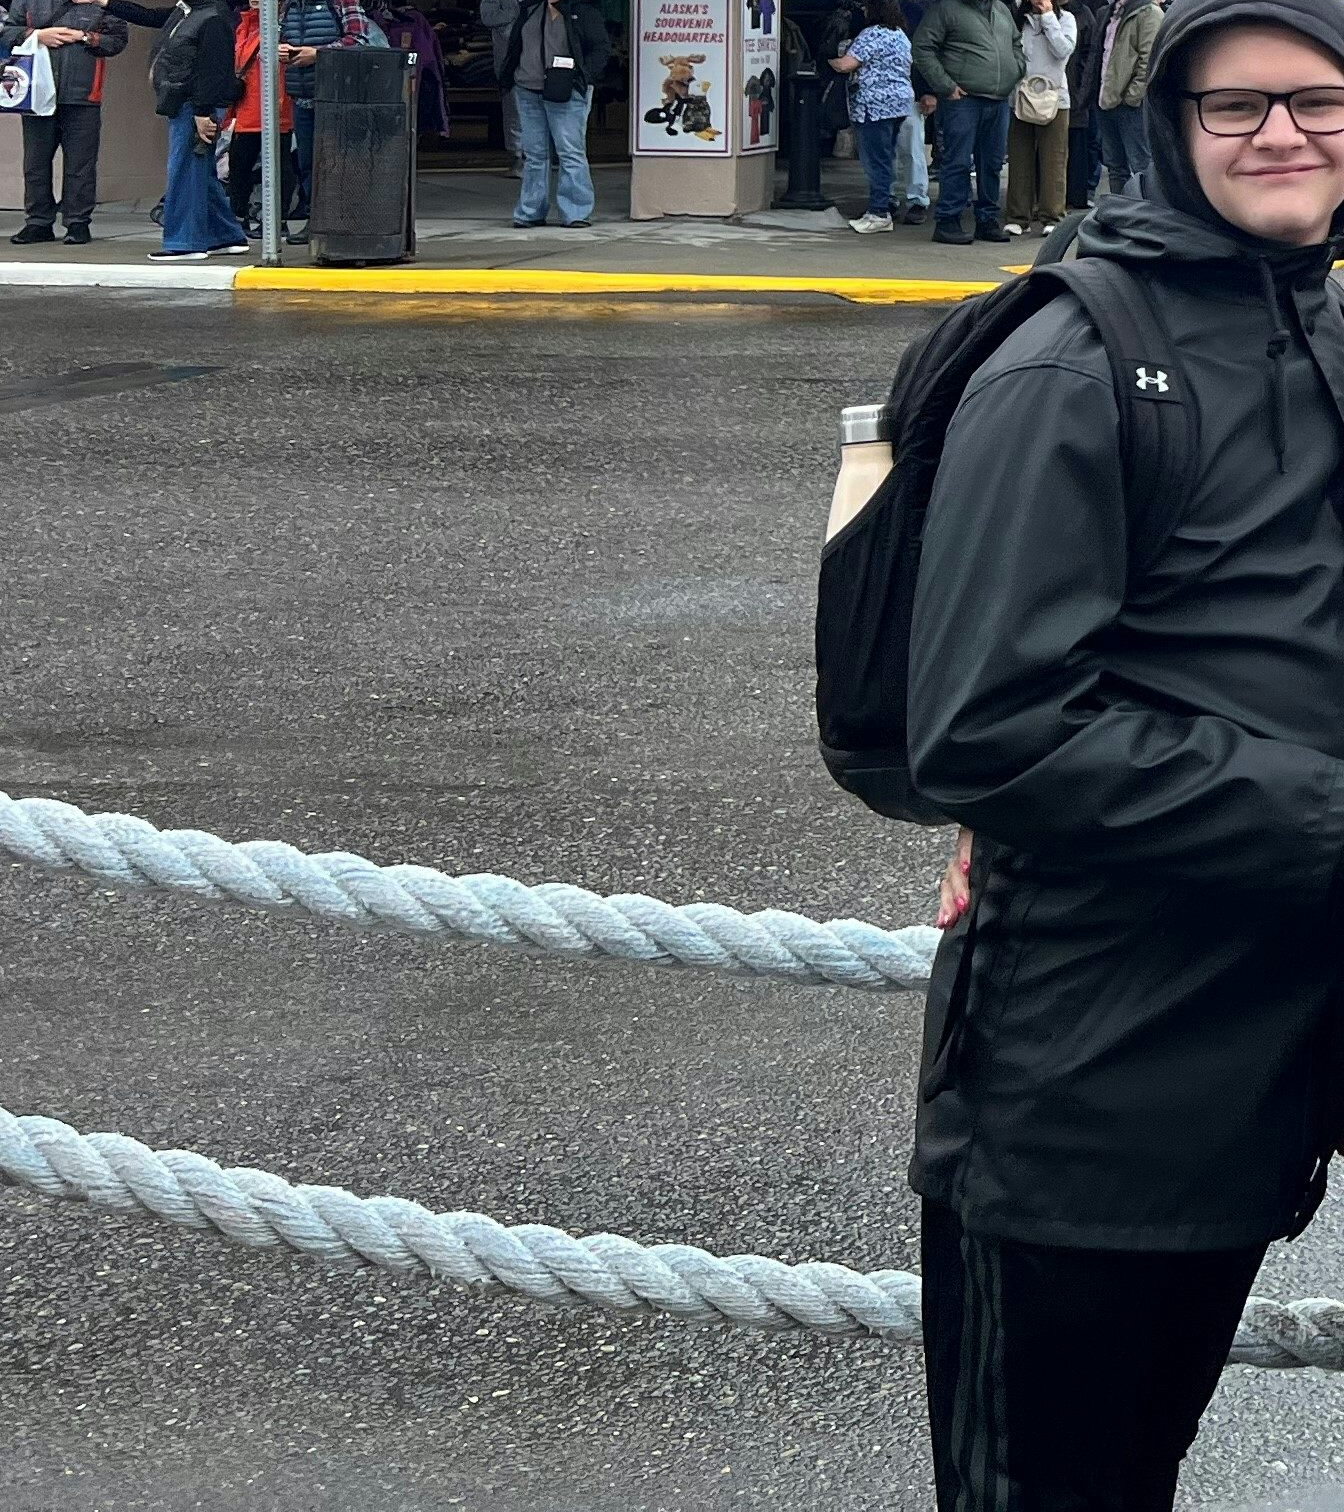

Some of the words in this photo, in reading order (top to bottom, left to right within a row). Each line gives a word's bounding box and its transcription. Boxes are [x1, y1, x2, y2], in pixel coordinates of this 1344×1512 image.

[660, 3, 709, 15] ALASKA'S
[655, 17, 714, 29] SOURVENIR
[643, 31, 725, 43] HEADQUARTERS
